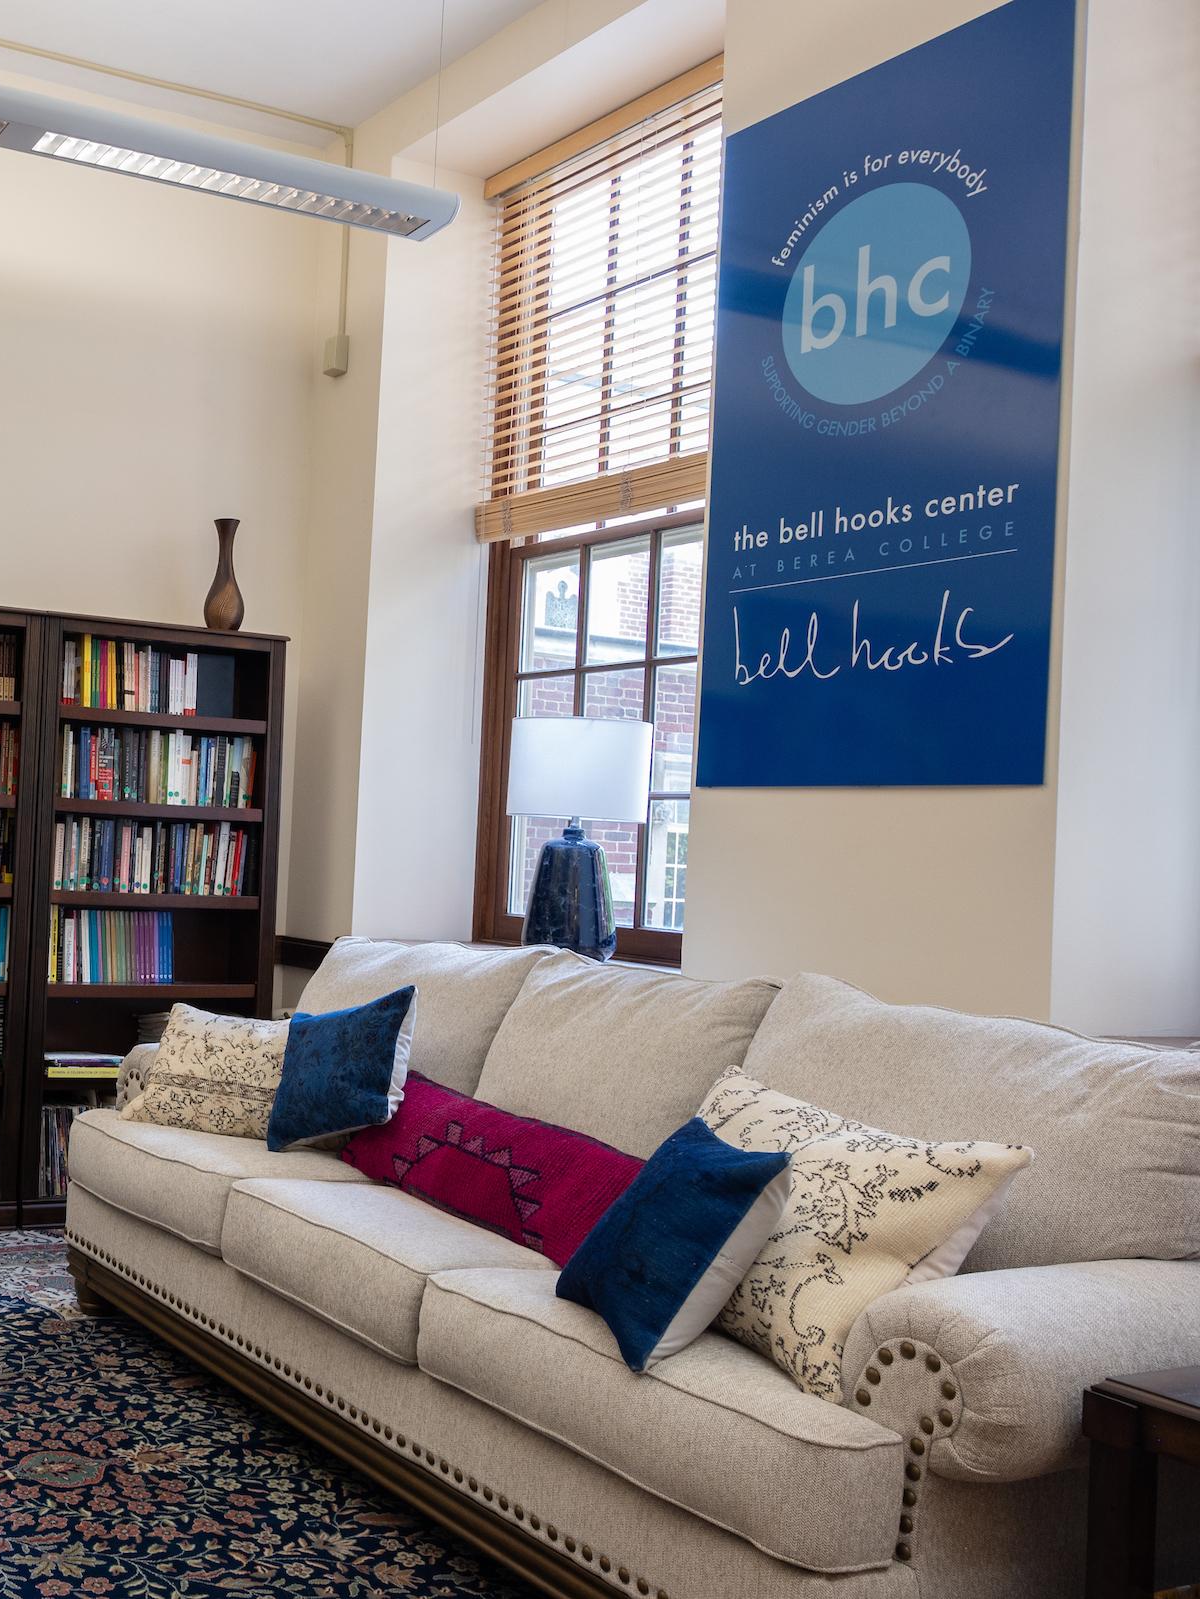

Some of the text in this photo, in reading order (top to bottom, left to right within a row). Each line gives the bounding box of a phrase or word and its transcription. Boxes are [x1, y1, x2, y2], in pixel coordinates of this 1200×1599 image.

[772, 148, 987, 267] feminism is for everybody
[800, 244, 950, 354] bhc
[761, 287, 995, 437] SUPPORTING GENDER BEYOND A BINARY
[733, 521, 1014, 579] AT BEREA COLLEGE
[734, 482, 1020, 551] the bell hooks center
[733, 590, 1014, 686] bell hooks
